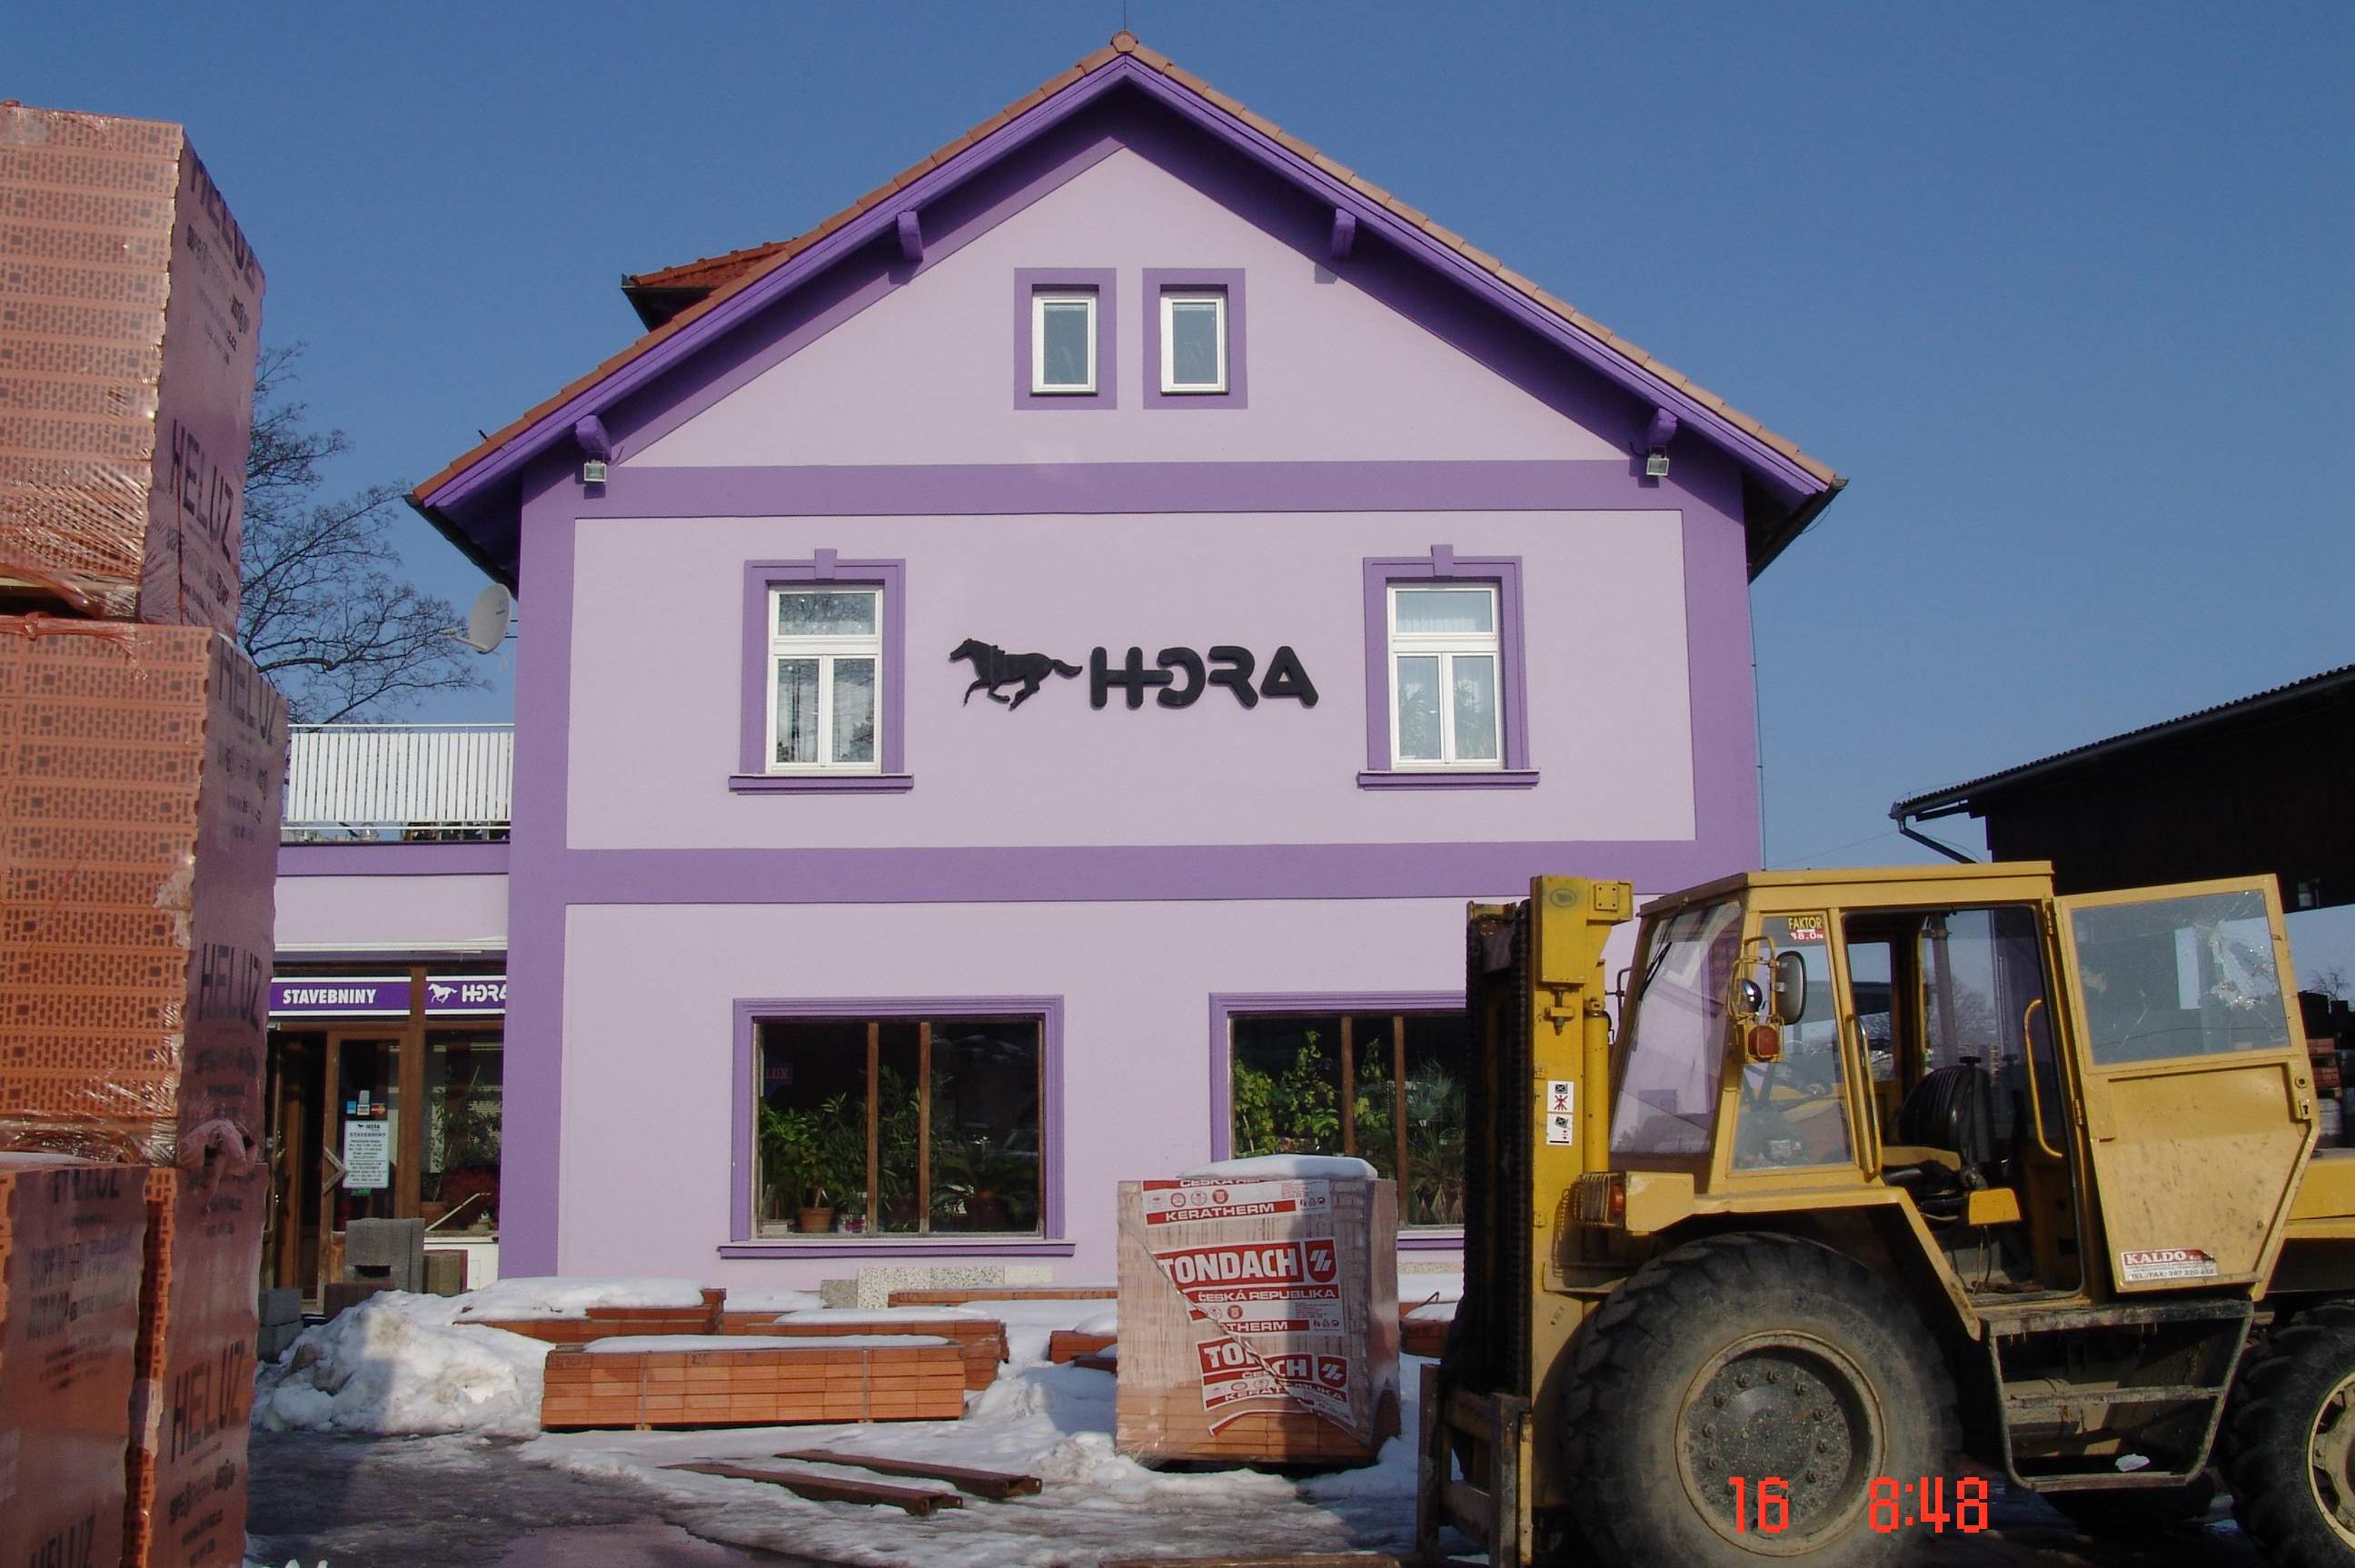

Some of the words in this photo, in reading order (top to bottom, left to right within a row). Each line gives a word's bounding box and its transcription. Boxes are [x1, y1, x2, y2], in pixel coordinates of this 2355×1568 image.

[1090, 646, 1318, 709] HORA
[1788, 917, 1823, 930] FAKTOR
[283, 988, 377, 1005] STAVEBNINY
[1165, 1203, 1275, 1222] KERATHERM
[1158, 1248, 1298, 1285] TONDACH
[2126, 1251, 2187, 1265] KALDO
[1198, 1289, 1247, 1302] ČESKÁ
[1249, 1288, 1336, 1300] REPUBLIKA
